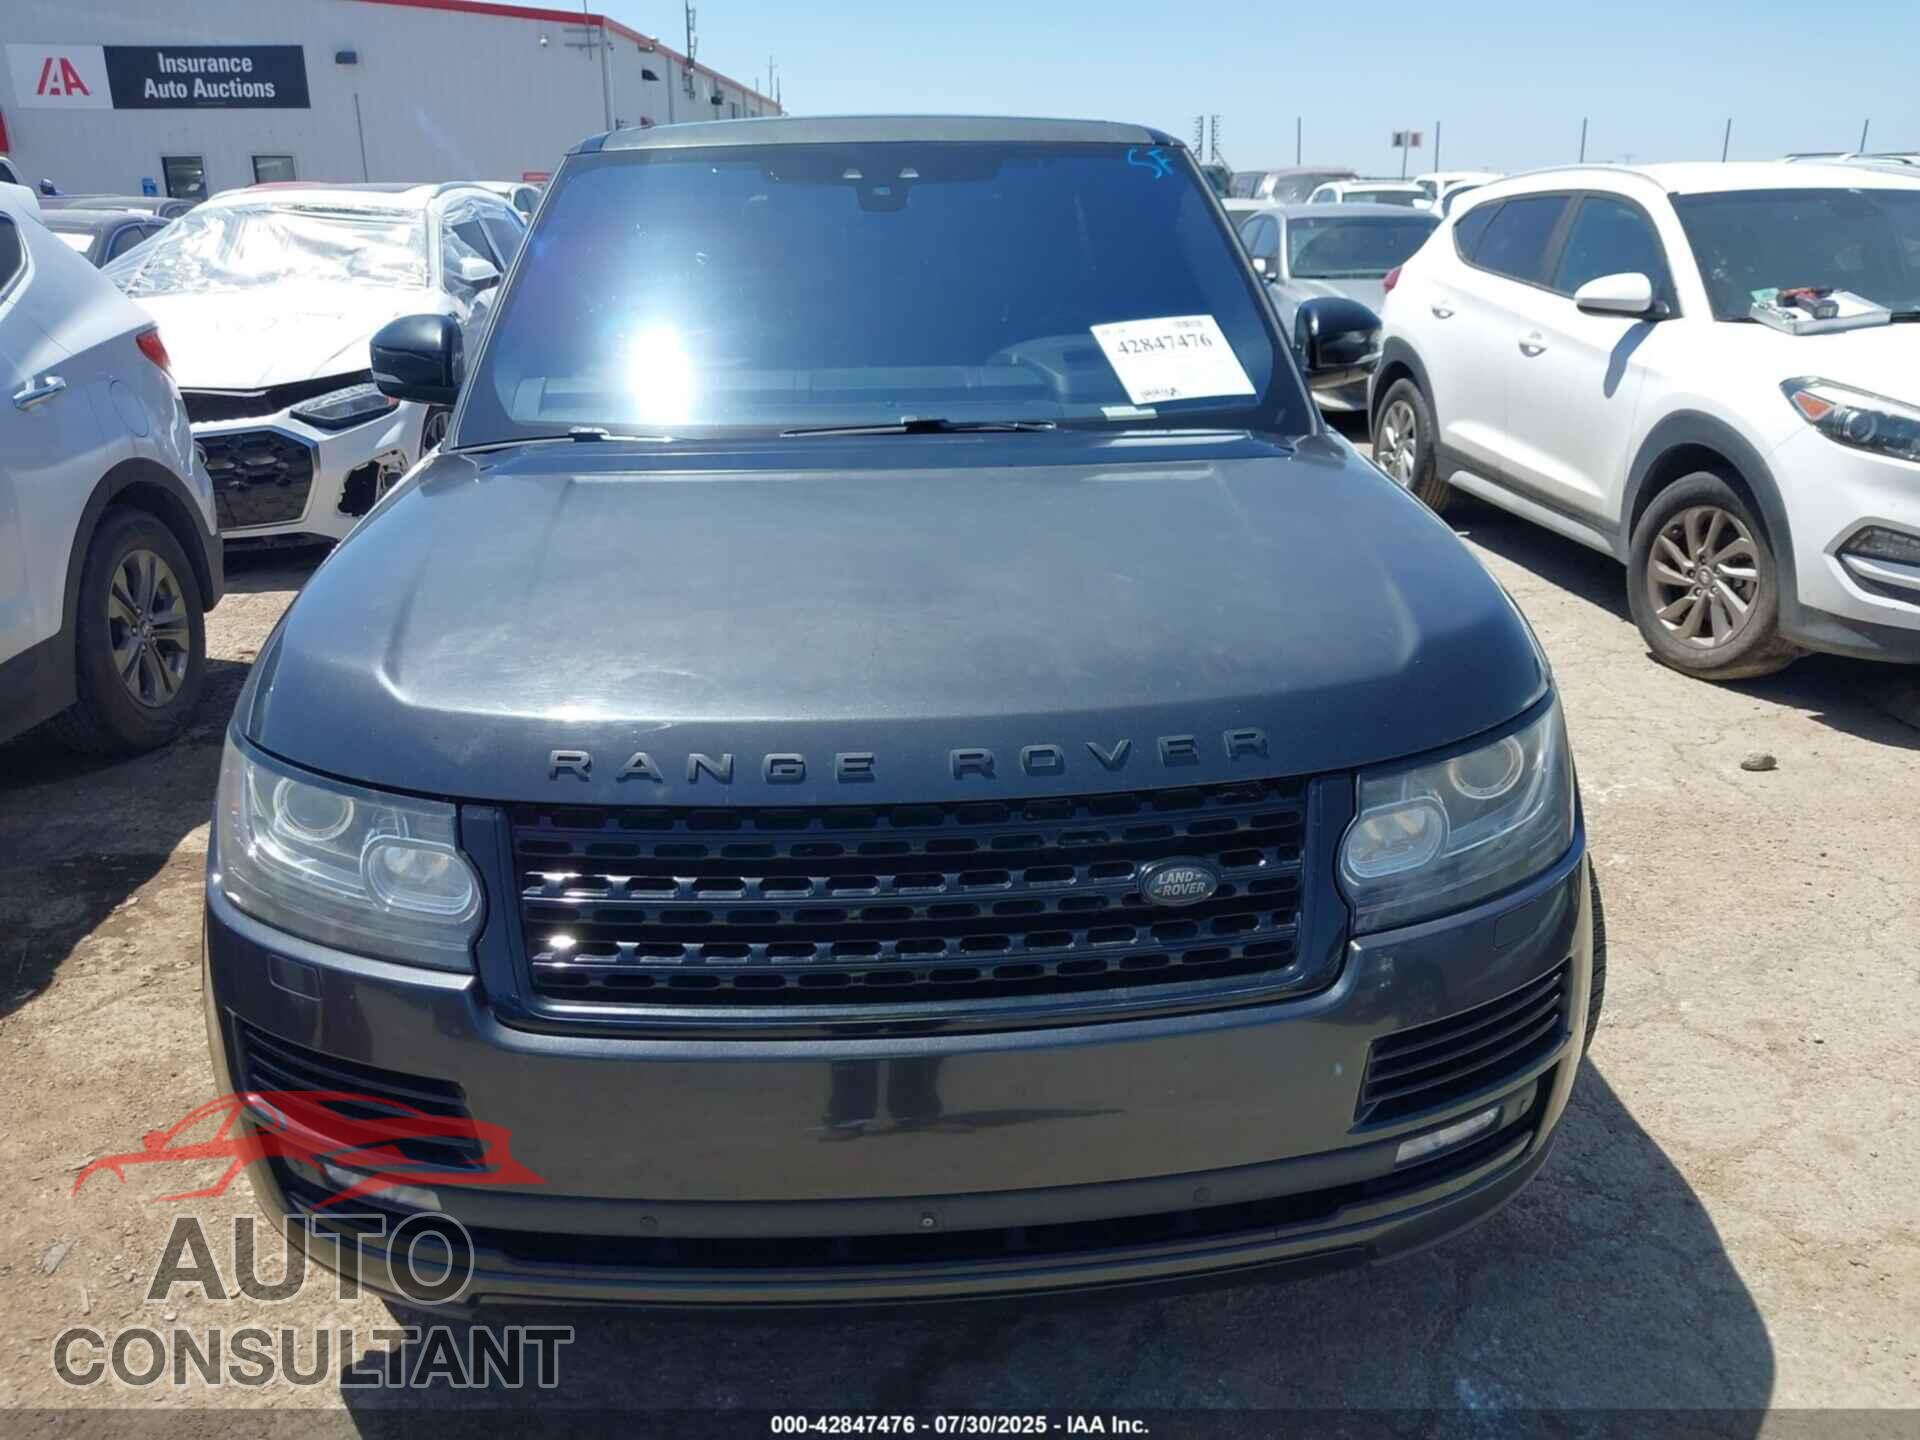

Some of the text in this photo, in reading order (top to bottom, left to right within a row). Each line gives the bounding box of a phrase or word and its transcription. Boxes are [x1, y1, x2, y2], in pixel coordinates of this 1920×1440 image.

[157, 52, 253, 74] Insurance
[144, 78, 276, 98] Auto Auctions
[1117, 334, 1213, 355] 42847476
[549, 727, 1269, 783] RANGE ROVER
[1158, 871, 1194, 884] LAND
[1161, 882, 1206, 896] ROVER
